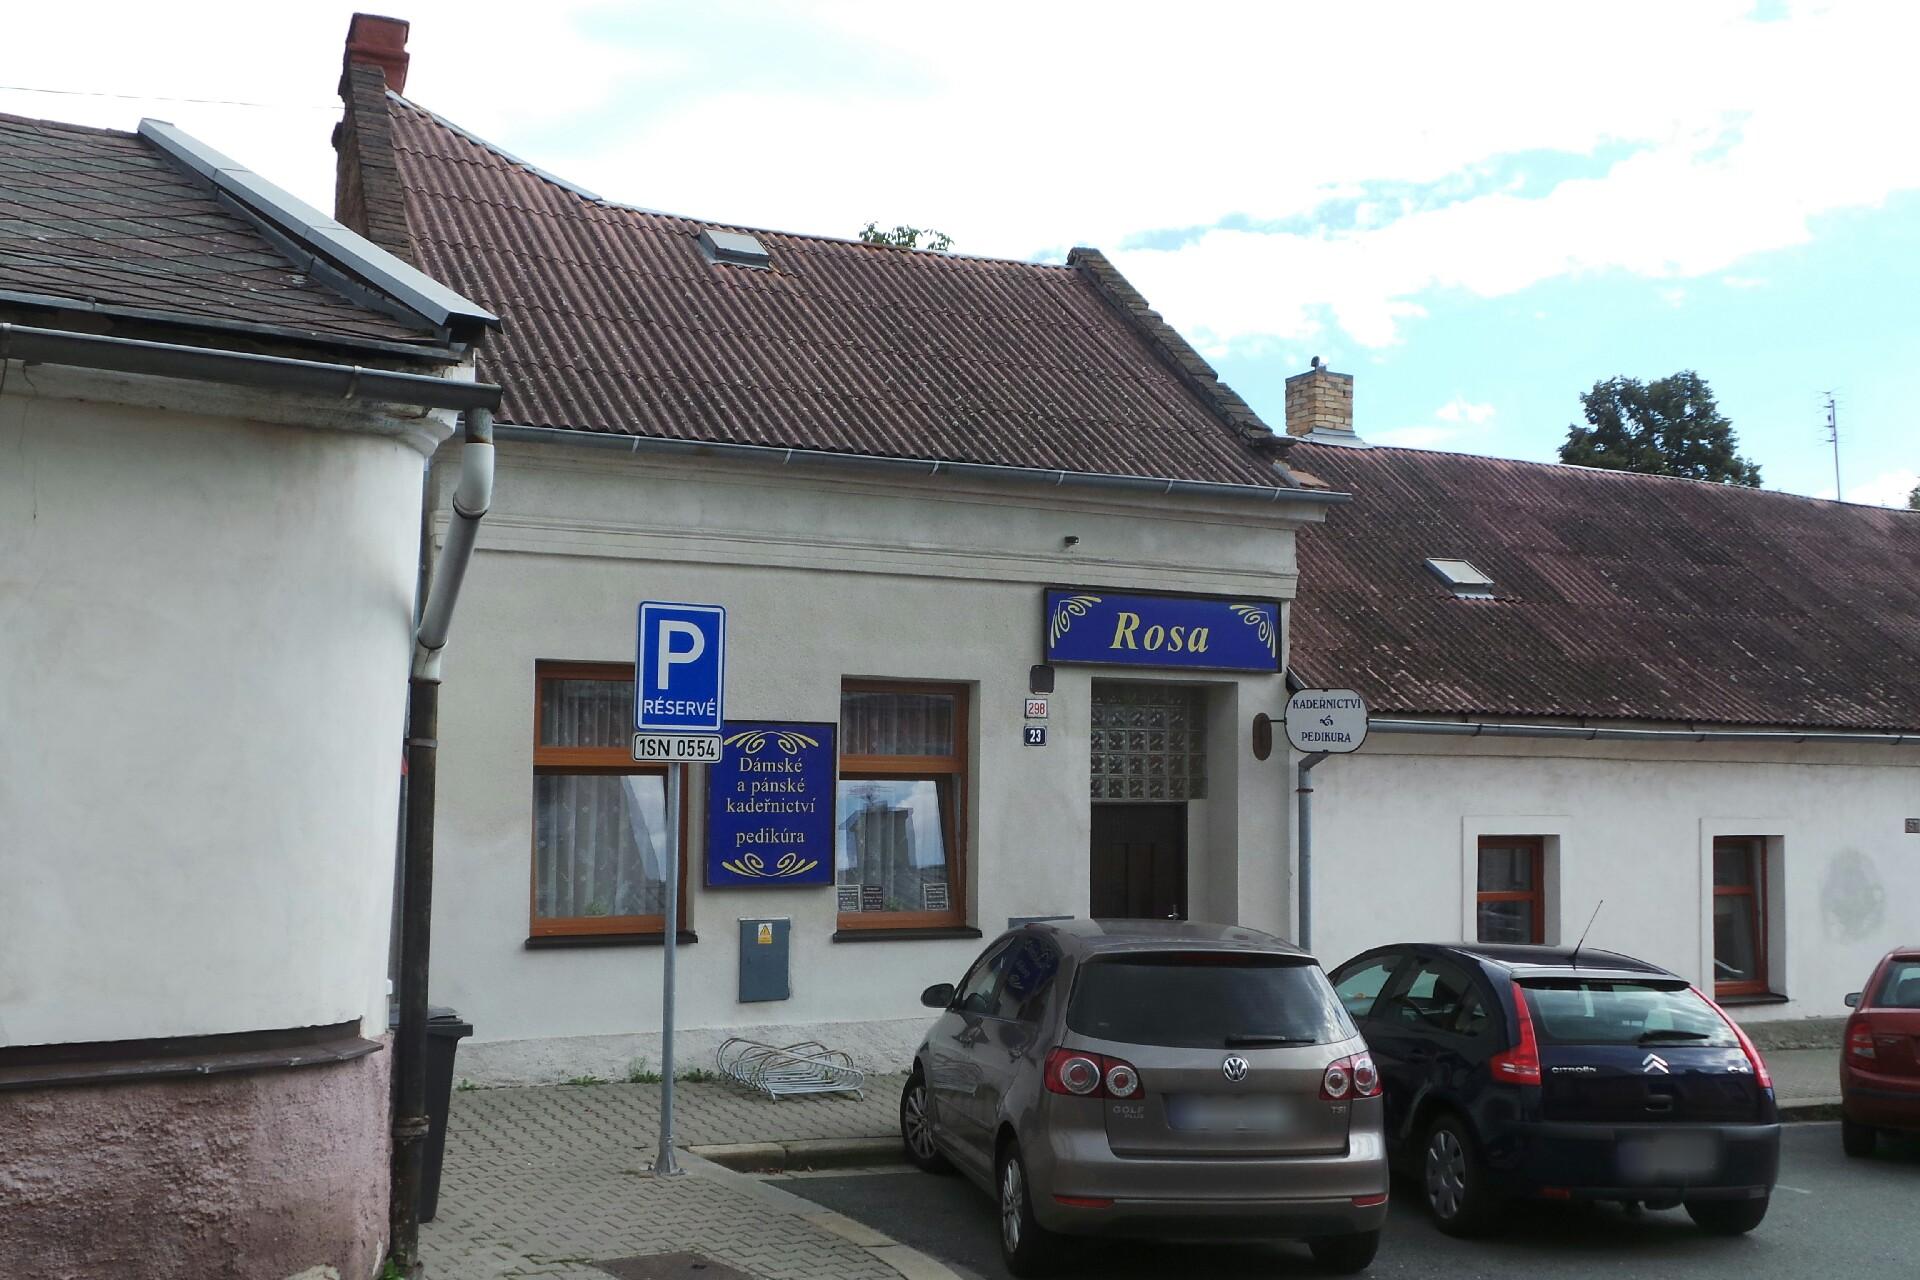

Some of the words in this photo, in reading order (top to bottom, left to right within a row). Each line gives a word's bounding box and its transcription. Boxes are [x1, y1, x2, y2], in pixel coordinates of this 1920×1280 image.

[1108, 612, 1209, 653] Rosa
[657, 619, 705, 690] P
[643, 695, 716, 716] RÉSERVÉ
[1028, 702, 1046, 715] 298
[1029, 729, 1042, 743] 23
[639, 738, 671, 756] 1SN
[677, 739, 716, 757] 0554
[739, 757, 803, 773] Dámské
[737, 780, 745, 792] a
[751, 777, 806, 796] pánské
[726, 797, 817, 813] kadeřnictví
[735, 827, 805, 848] pedikúra
[1112, 1105, 1145, 1114] GOLF
